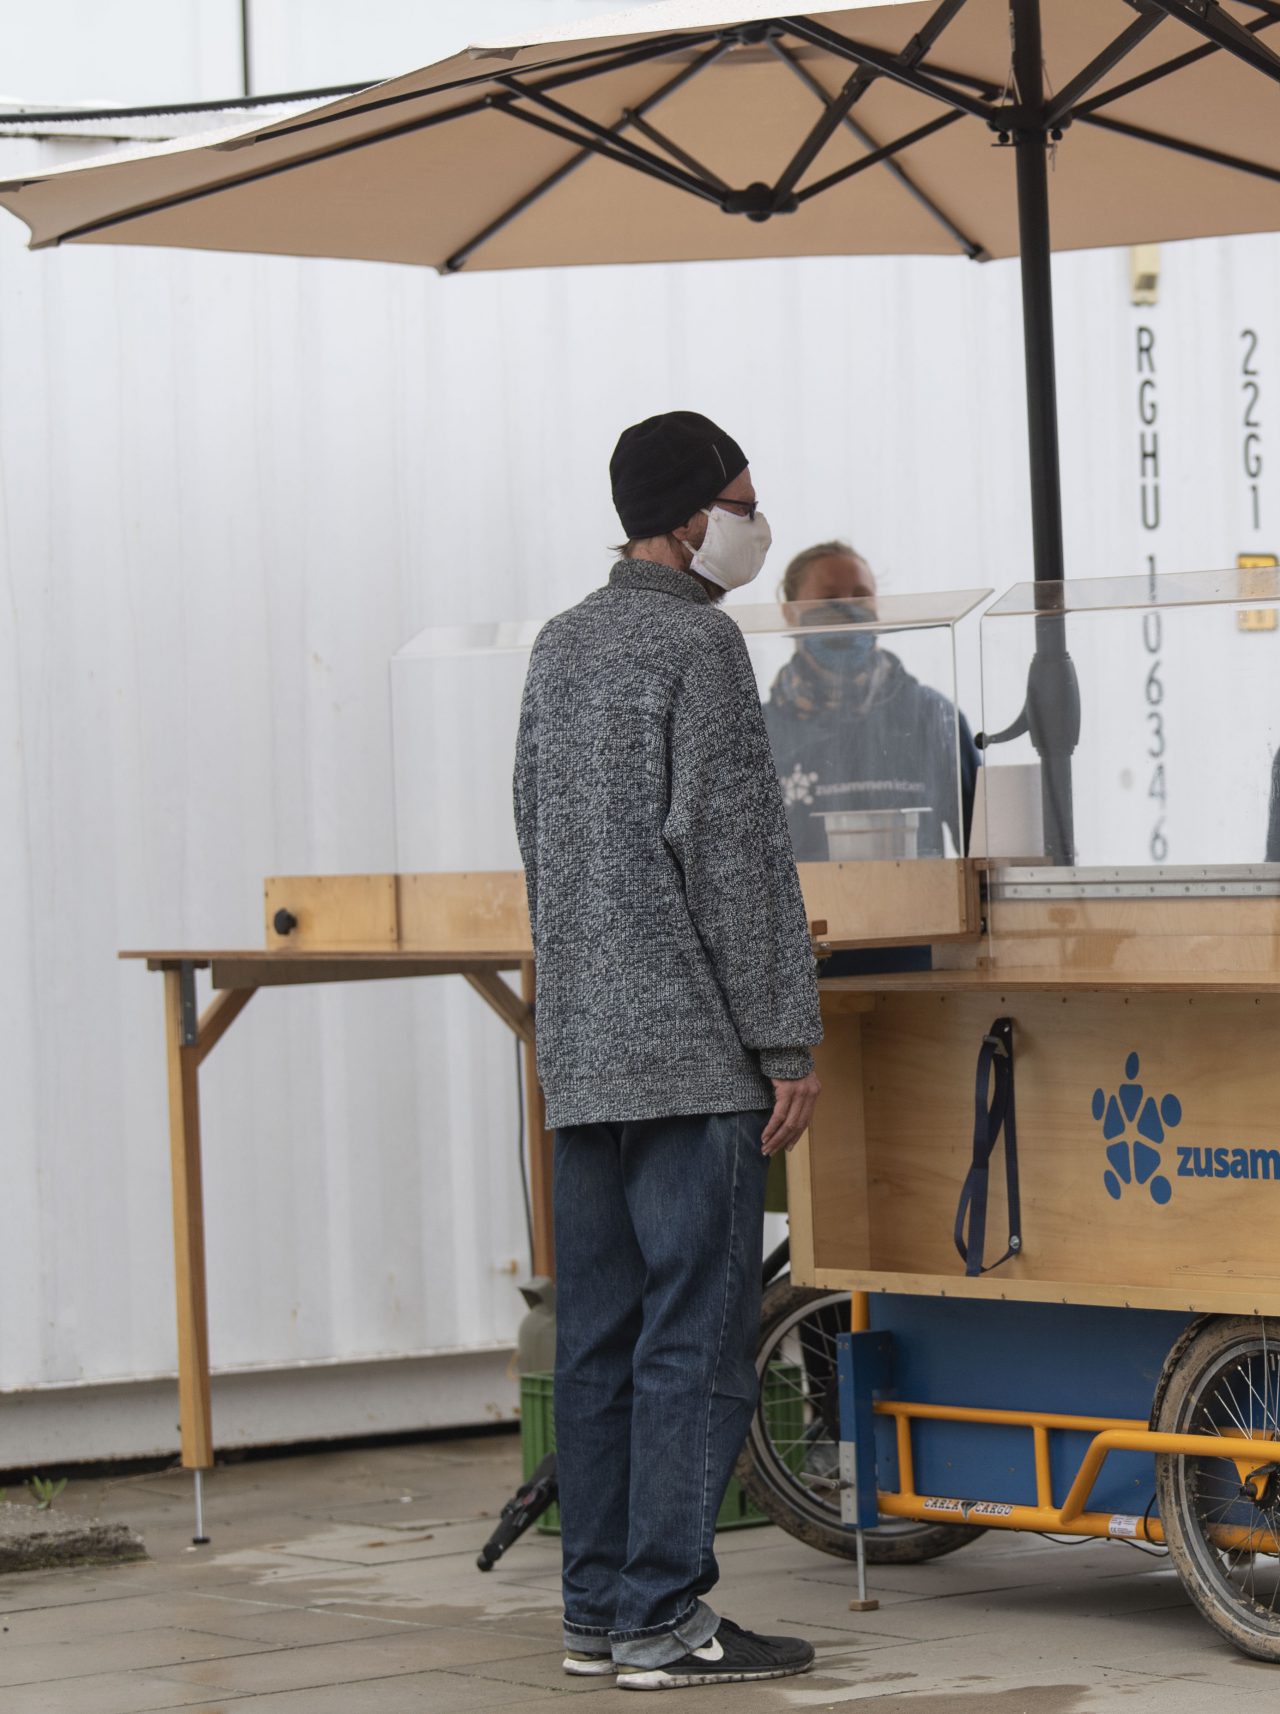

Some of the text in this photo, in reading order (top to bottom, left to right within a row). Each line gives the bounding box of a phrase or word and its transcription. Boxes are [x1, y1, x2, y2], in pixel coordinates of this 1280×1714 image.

[1136, 326, 1160, 531] RGHU
[1240, 329, 1262, 530] 22G1
[924, 1498, 1013, 1515] CARLA CARGO
